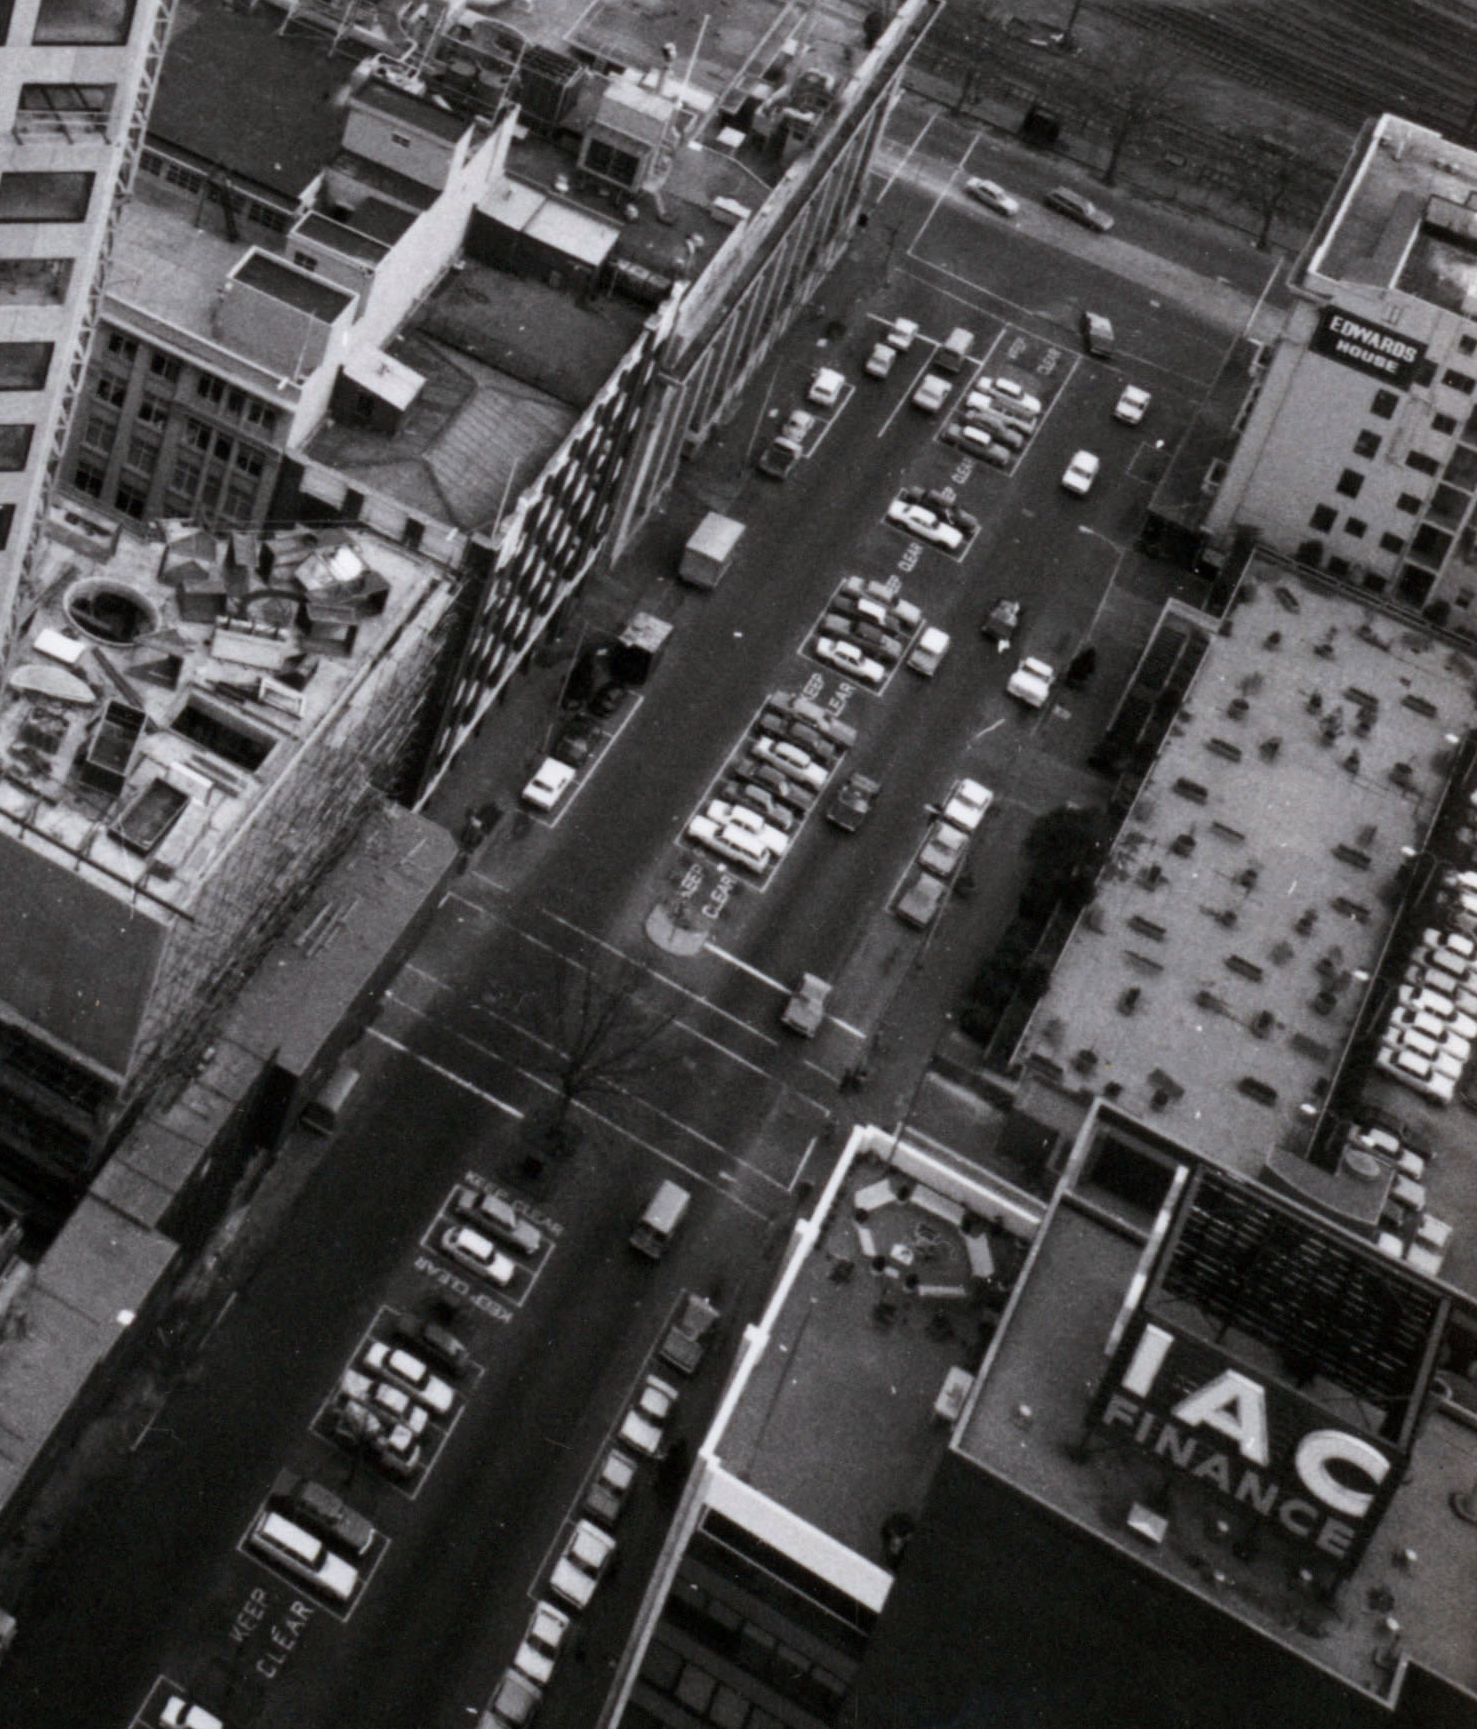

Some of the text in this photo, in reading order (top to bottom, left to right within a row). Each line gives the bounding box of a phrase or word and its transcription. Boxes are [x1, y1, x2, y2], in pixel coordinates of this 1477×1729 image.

[1329, 315, 1417, 363] EDWARDS
[1335, 339, 1399, 374] HOUSE
[897, 542, 923, 572] CLEAR
[825, 682, 856, 717] LEAR
[702, 874, 737, 919] CLEAR
[513, 1200, 564, 1237] CLEAR
[414, 1255, 470, 1295] CLEAR
[1121, 1323, 1391, 1518] IAC
[1102, 1392, 1357, 1559] FINANCE
[229, 1588, 268, 1642] KEEP
[256, 1601, 315, 1678] CLEAR
